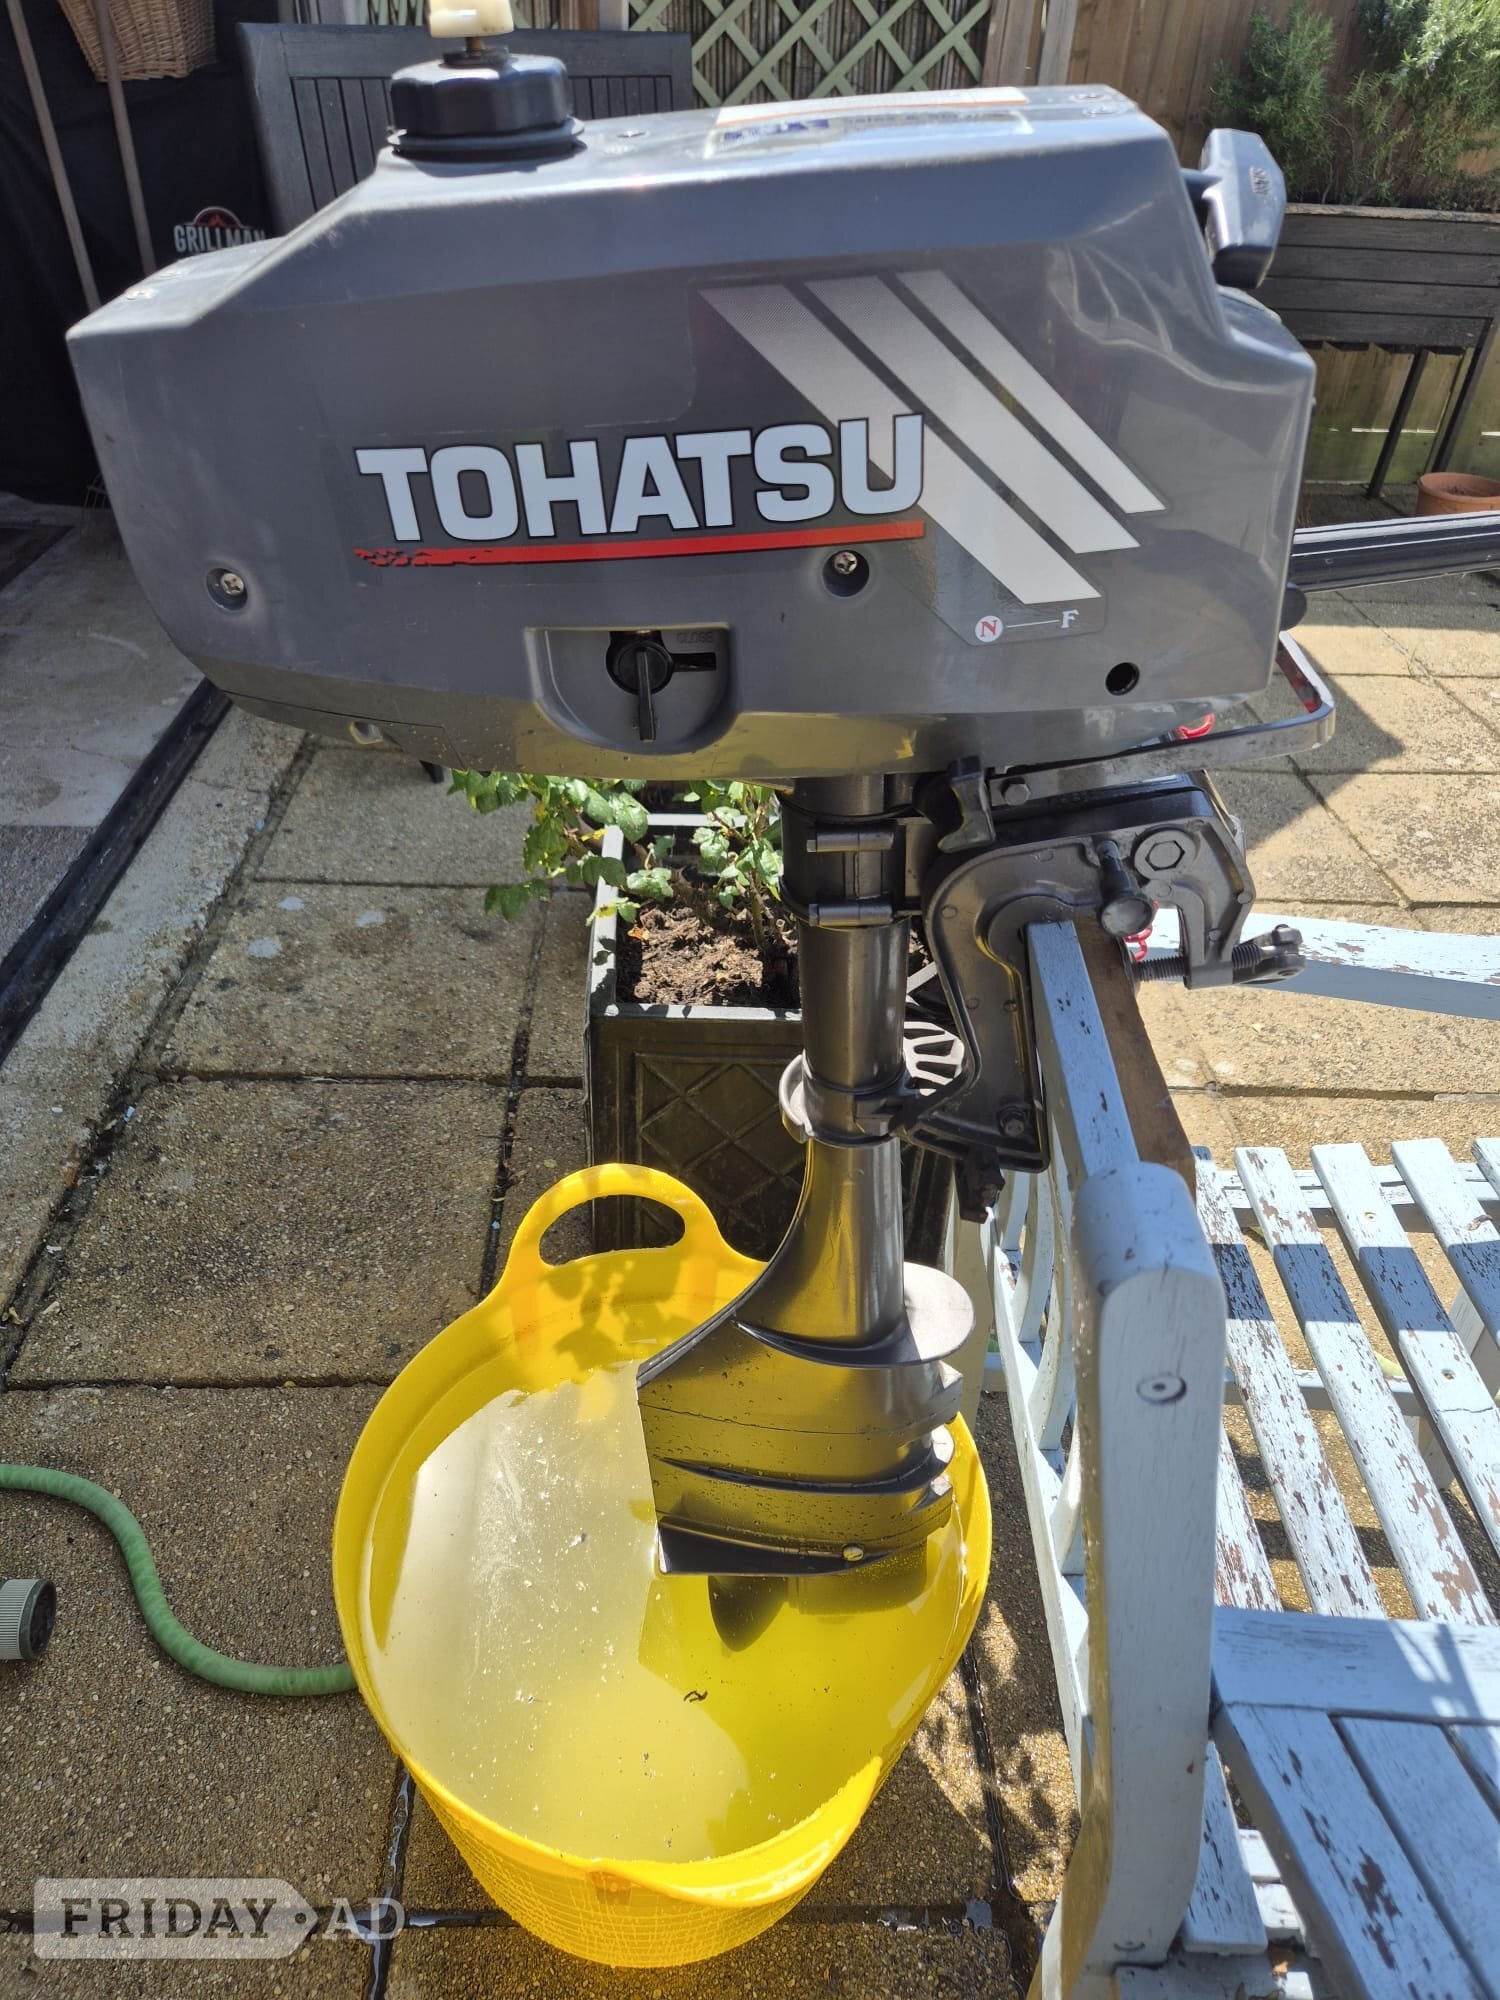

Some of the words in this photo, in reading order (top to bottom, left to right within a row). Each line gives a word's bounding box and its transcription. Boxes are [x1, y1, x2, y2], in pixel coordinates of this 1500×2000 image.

[354, 414, 924, 542] TOHATSU
[980, 620, 998, 637] N
[1061, 609, 1079, 628] F
